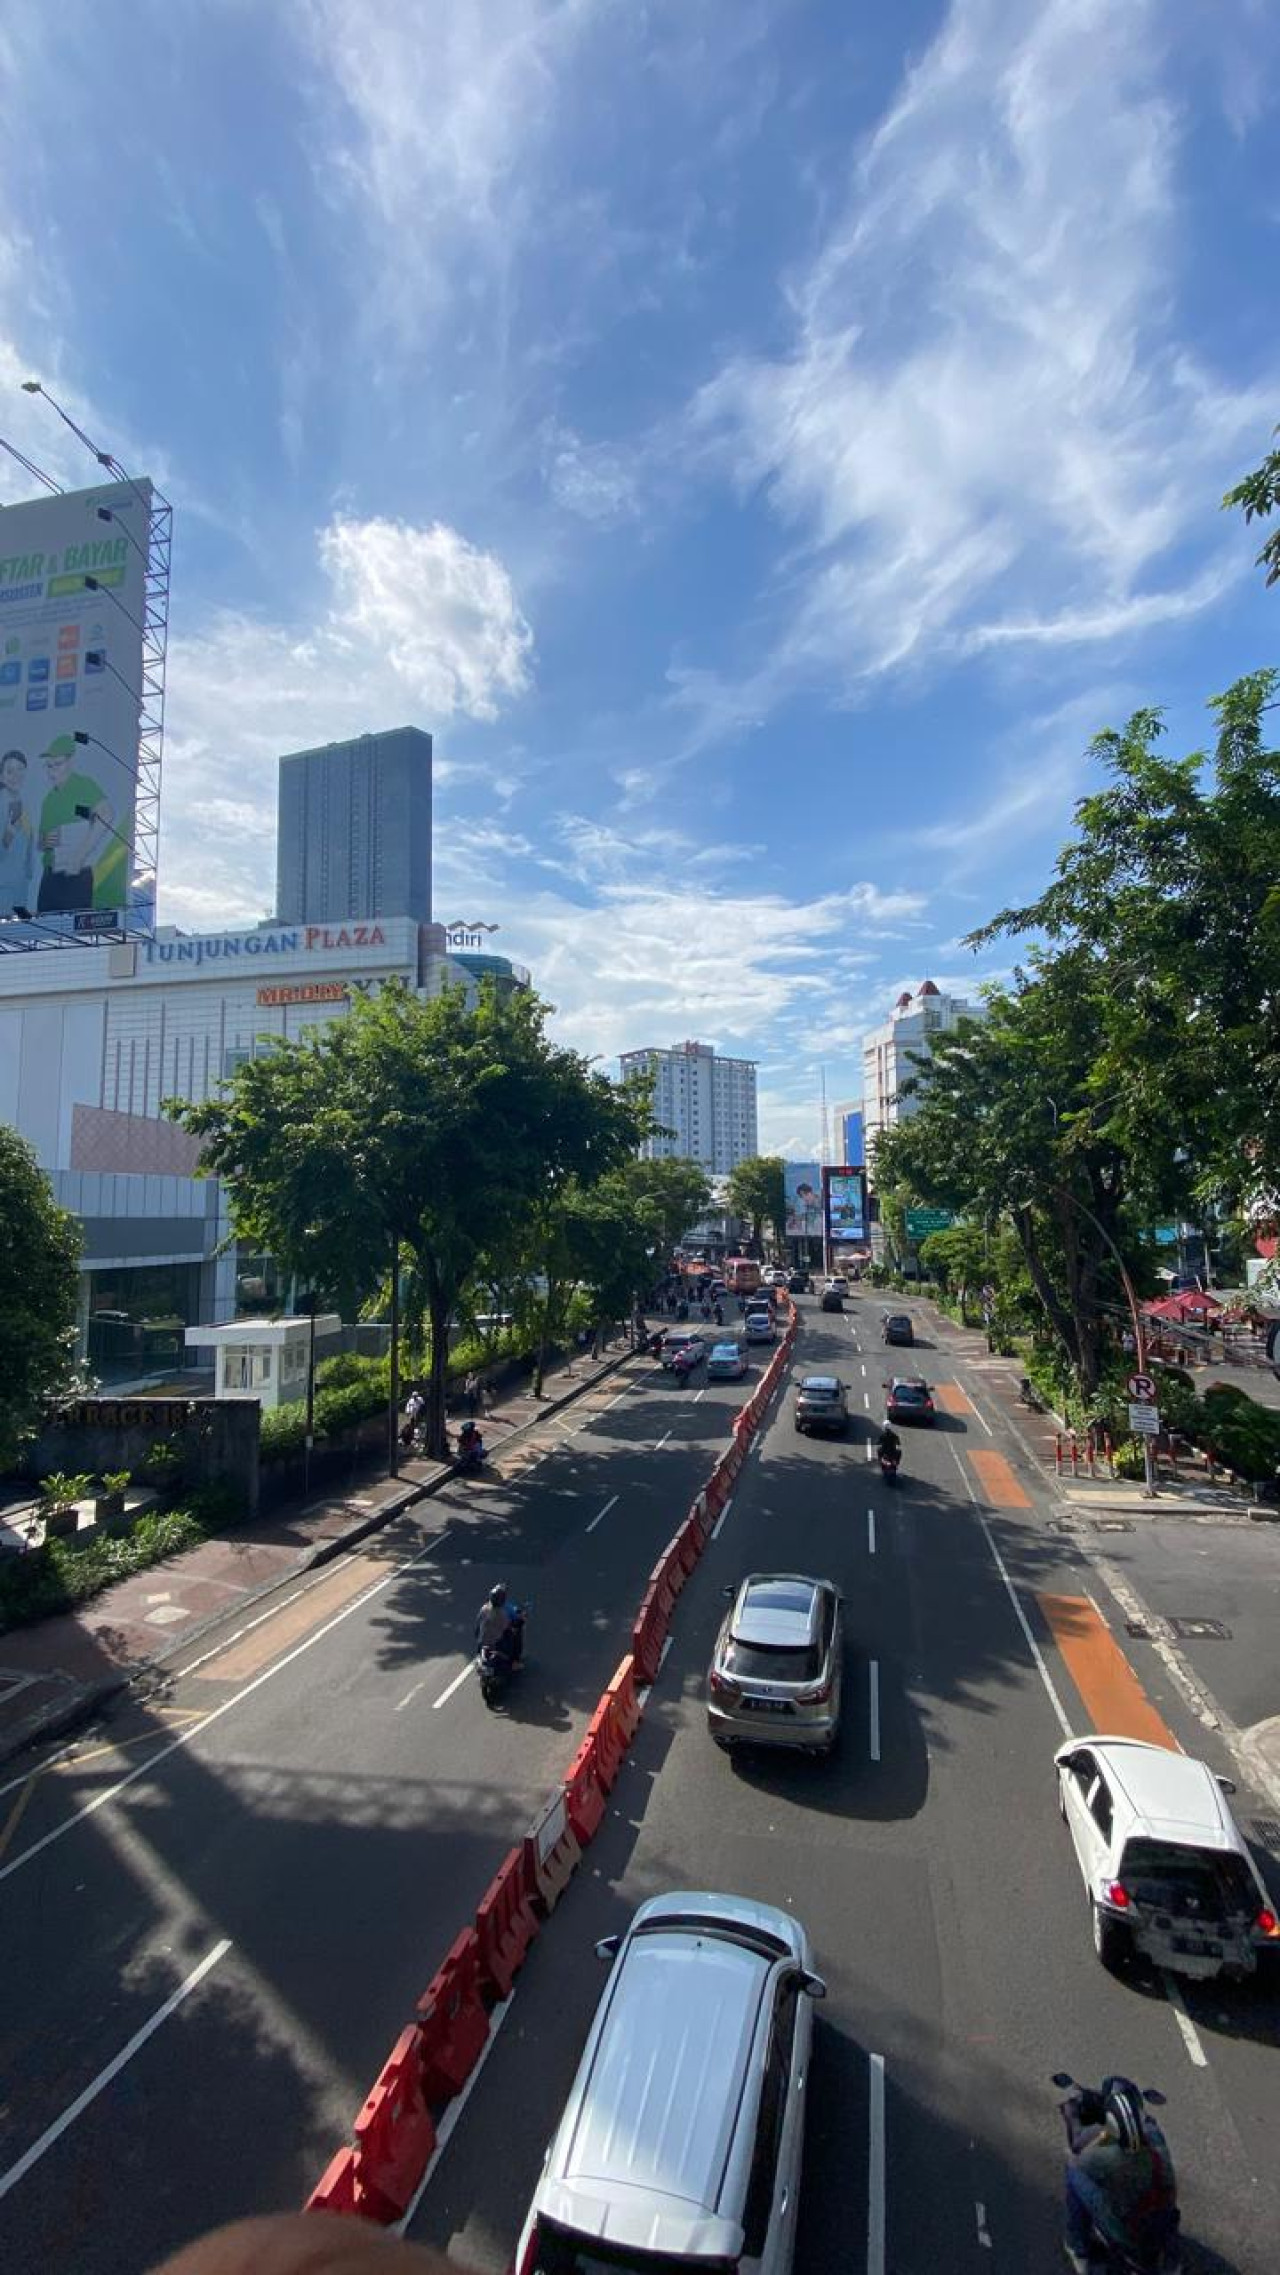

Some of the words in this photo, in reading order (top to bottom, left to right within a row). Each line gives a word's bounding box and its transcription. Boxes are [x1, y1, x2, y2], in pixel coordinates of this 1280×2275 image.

[65, 538, 127, 570] BAYAR
[144, 932, 298, 965] TUNJUNGAN
[303, 925, 385, 950] PLAZA
